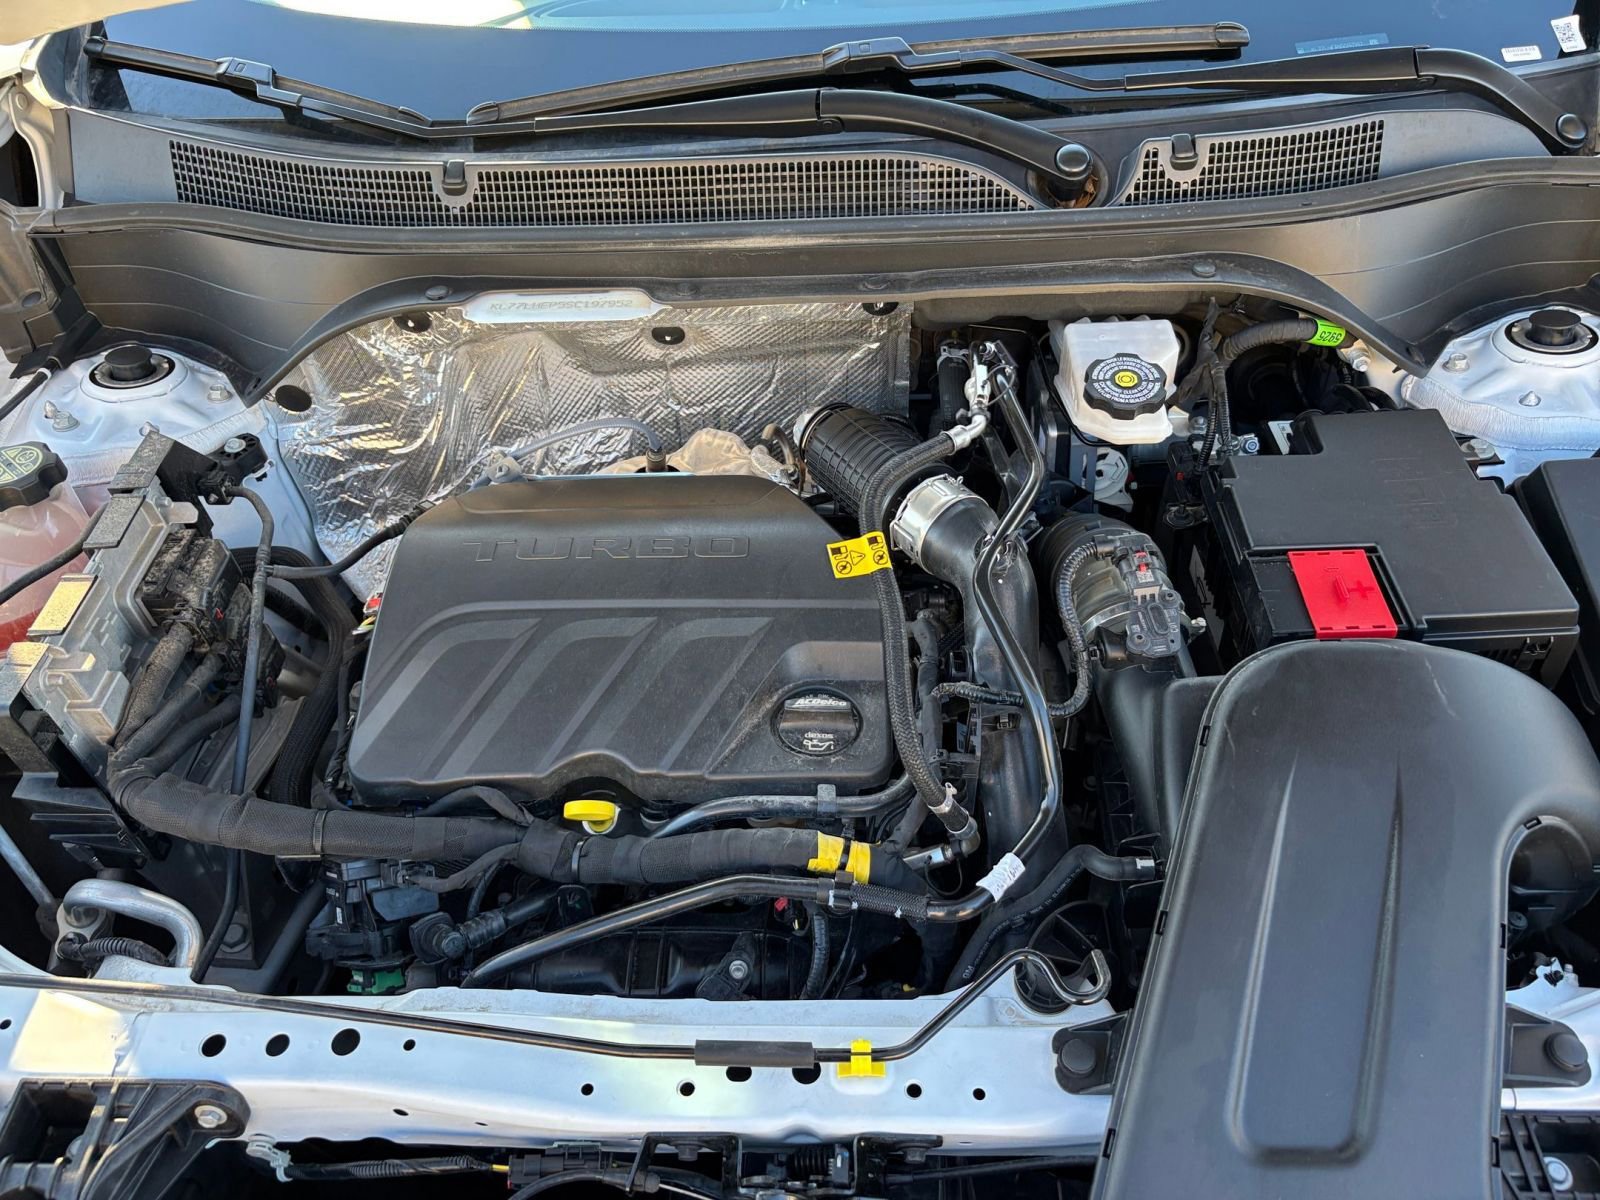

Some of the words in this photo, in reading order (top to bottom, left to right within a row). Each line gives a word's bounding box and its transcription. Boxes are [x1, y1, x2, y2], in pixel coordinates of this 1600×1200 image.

[1317, 330, 1343, 343] 5925
[463, 536, 750, 562] TURBO
[794, 698, 847, 706] ACDelco
[804, 731, 834, 739] dexos
